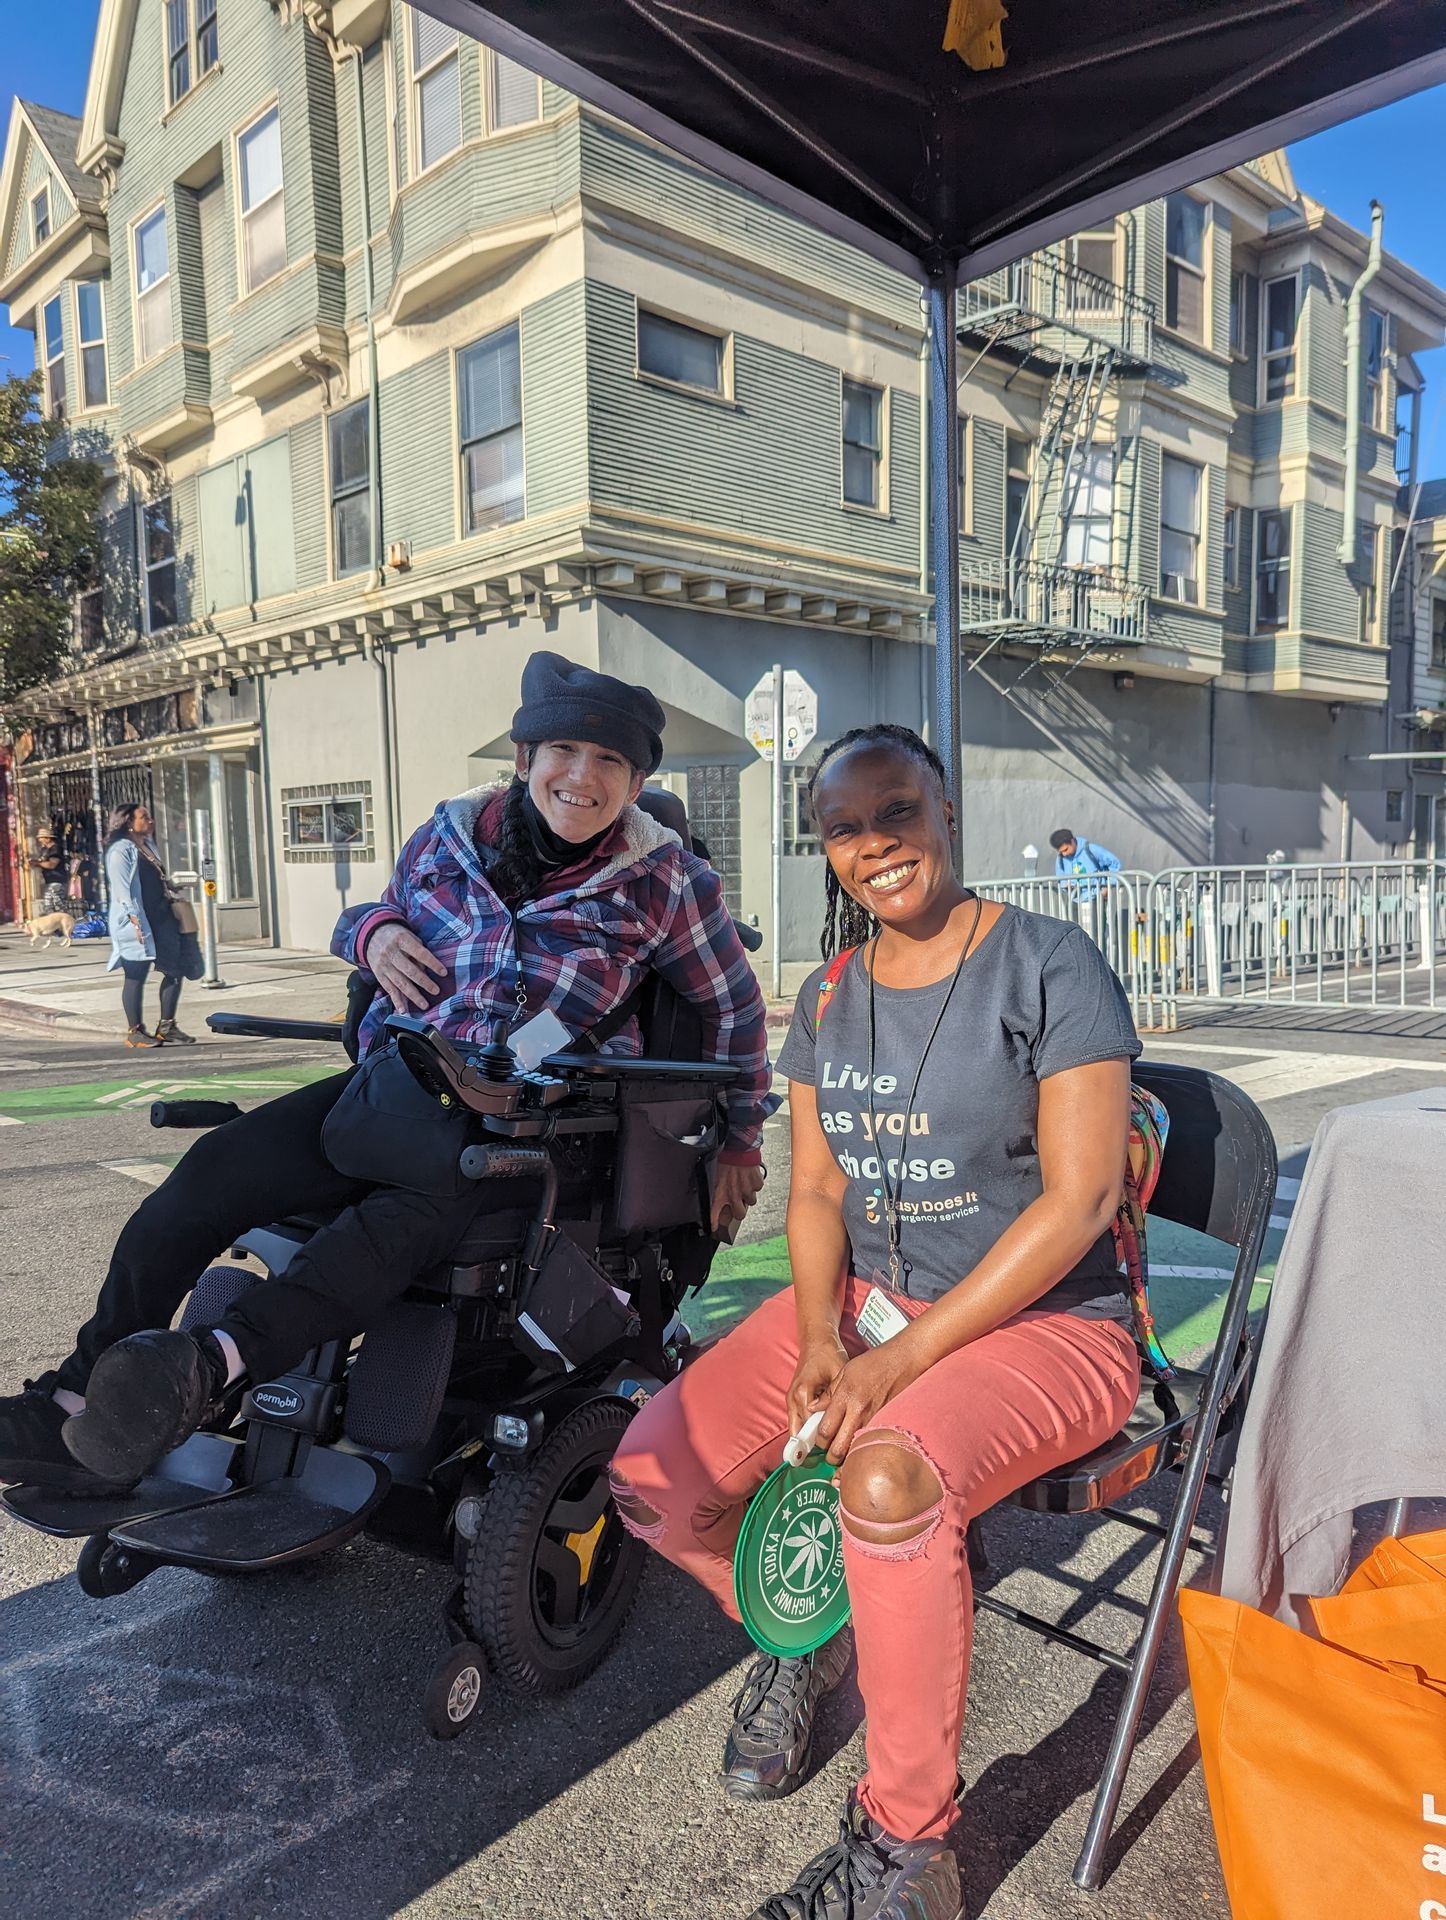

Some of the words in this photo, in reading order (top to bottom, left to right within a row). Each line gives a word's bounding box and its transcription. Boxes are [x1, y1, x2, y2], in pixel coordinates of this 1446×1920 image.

[821, 1062, 898, 1094] Live
[821, 1111, 854, 1133] as
[860, 1112, 930, 1141] you
[838, 1149, 956, 1182] choose
[922, 1196, 963, 1213] Does
[965, 1191, 979, 1204] It
[940, 1205, 980, 1222] services
[256, 1392, 297, 1408] permobil
[796, 1489, 826, 1508] WATER
[764, 1533, 781, 1587] VODKA
[772, 1587, 816, 1616] HIGHWAY
